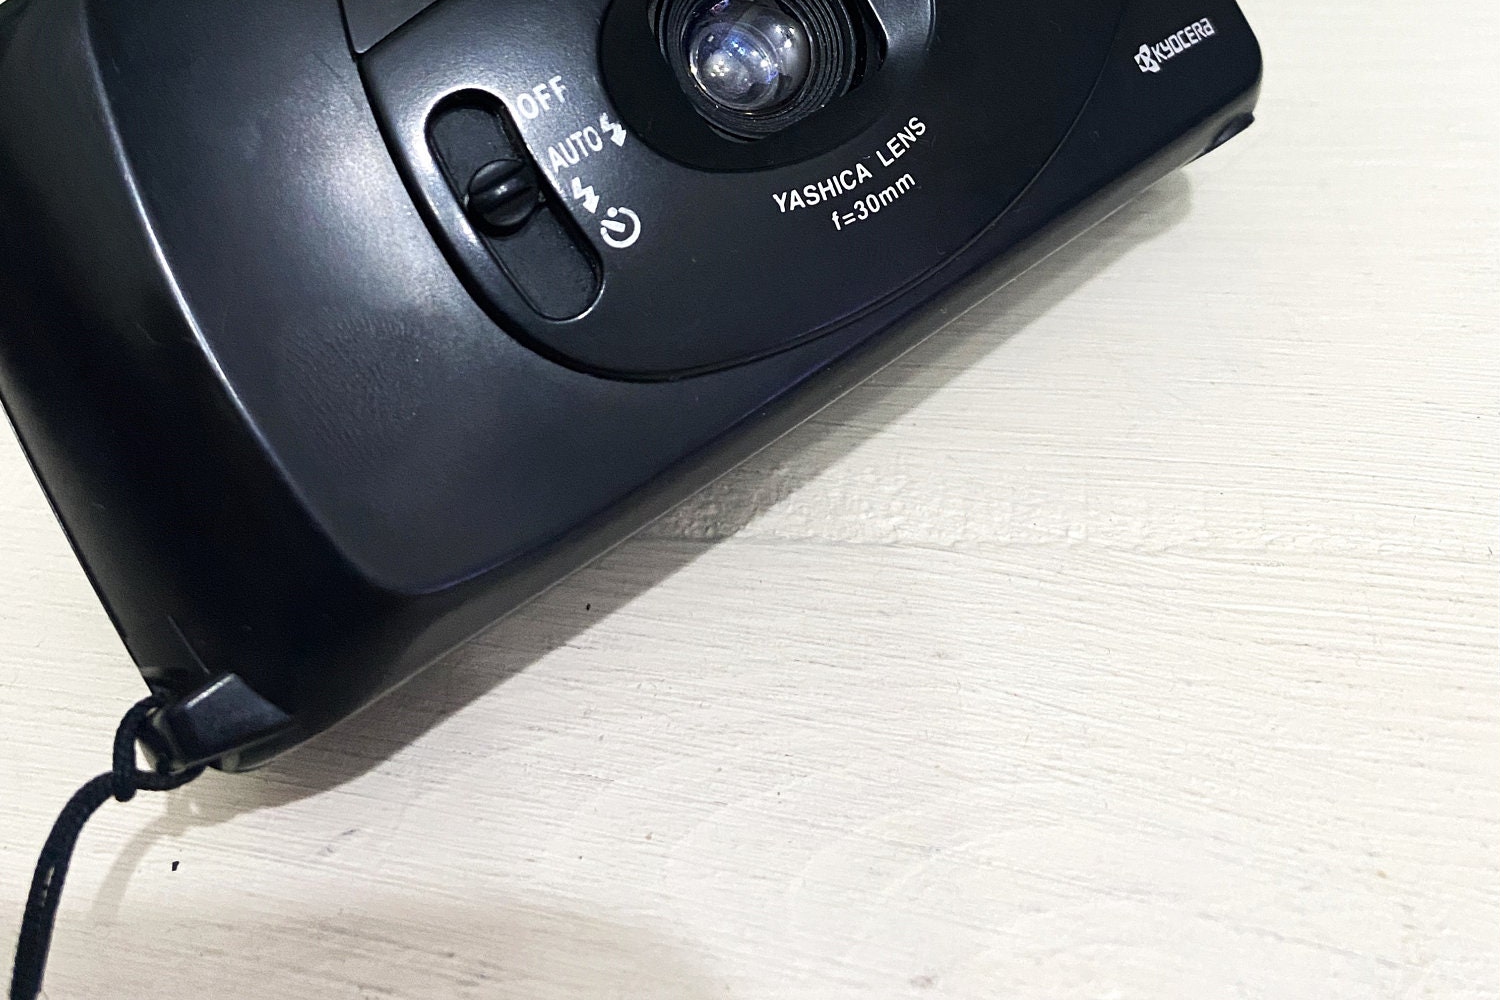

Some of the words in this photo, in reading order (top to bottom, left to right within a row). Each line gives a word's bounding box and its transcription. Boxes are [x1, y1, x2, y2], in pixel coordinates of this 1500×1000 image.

[517, 75, 566, 120] OFF
[547, 126, 603, 174] AUTO
[772, 164, 872, 213] YASHICA
[876, 116, 927, 167] LENS
[831, 170, 916, 231] f=30mm
